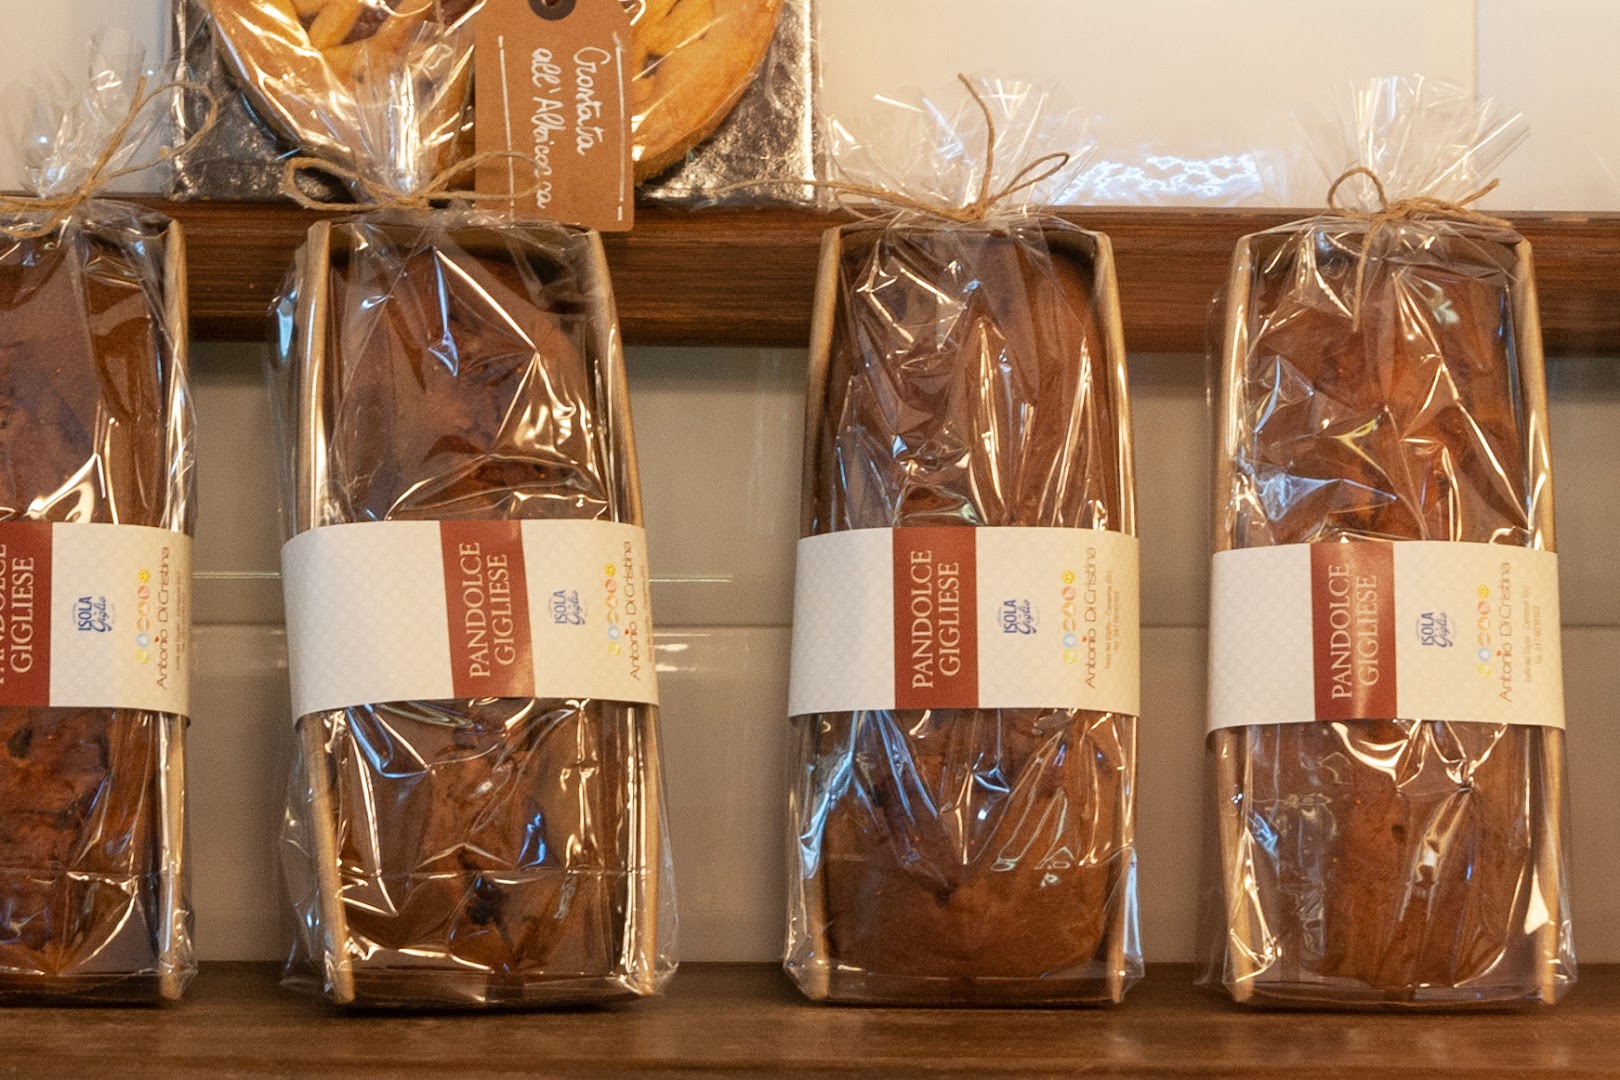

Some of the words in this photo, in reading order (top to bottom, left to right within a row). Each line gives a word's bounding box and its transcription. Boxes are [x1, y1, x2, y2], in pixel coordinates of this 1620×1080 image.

[573, 46, 612, 156] Crostata
[10, 557, 35, 674] GIGLIESE
[78, 596, 92, 631] ISOLA
[90, 596, 112, 633] Giglio
[459, 541, 491, 679] PANDOLCE
[486, 554, 516, 666] GIGLIESE
[553, 590, 568, 624] ISOLA
[566, 590, 586, 626] Giglio
[910, 550, 933, 689] PANDOLCE
[938, 562, 961, 676] GIGLIESE
[1003, 599, 1017, 634] ISOLA
[1016, 598, 1037, 635] Giglio
[1328, 563, 1353, 700] PANDOLCE
[1356, 575, 1380, 687] GIGLIESE
[1421, 612, 1434, 646] ISOLA
[1433, 612, 1453, 648] Giglio
[154, 629, 169, 690] Antonio
[625, 621, 641, 681] Antonio
[1082, 628, 1097, 689] Antonio
[1496, 643, 1512, 702] Antonio
